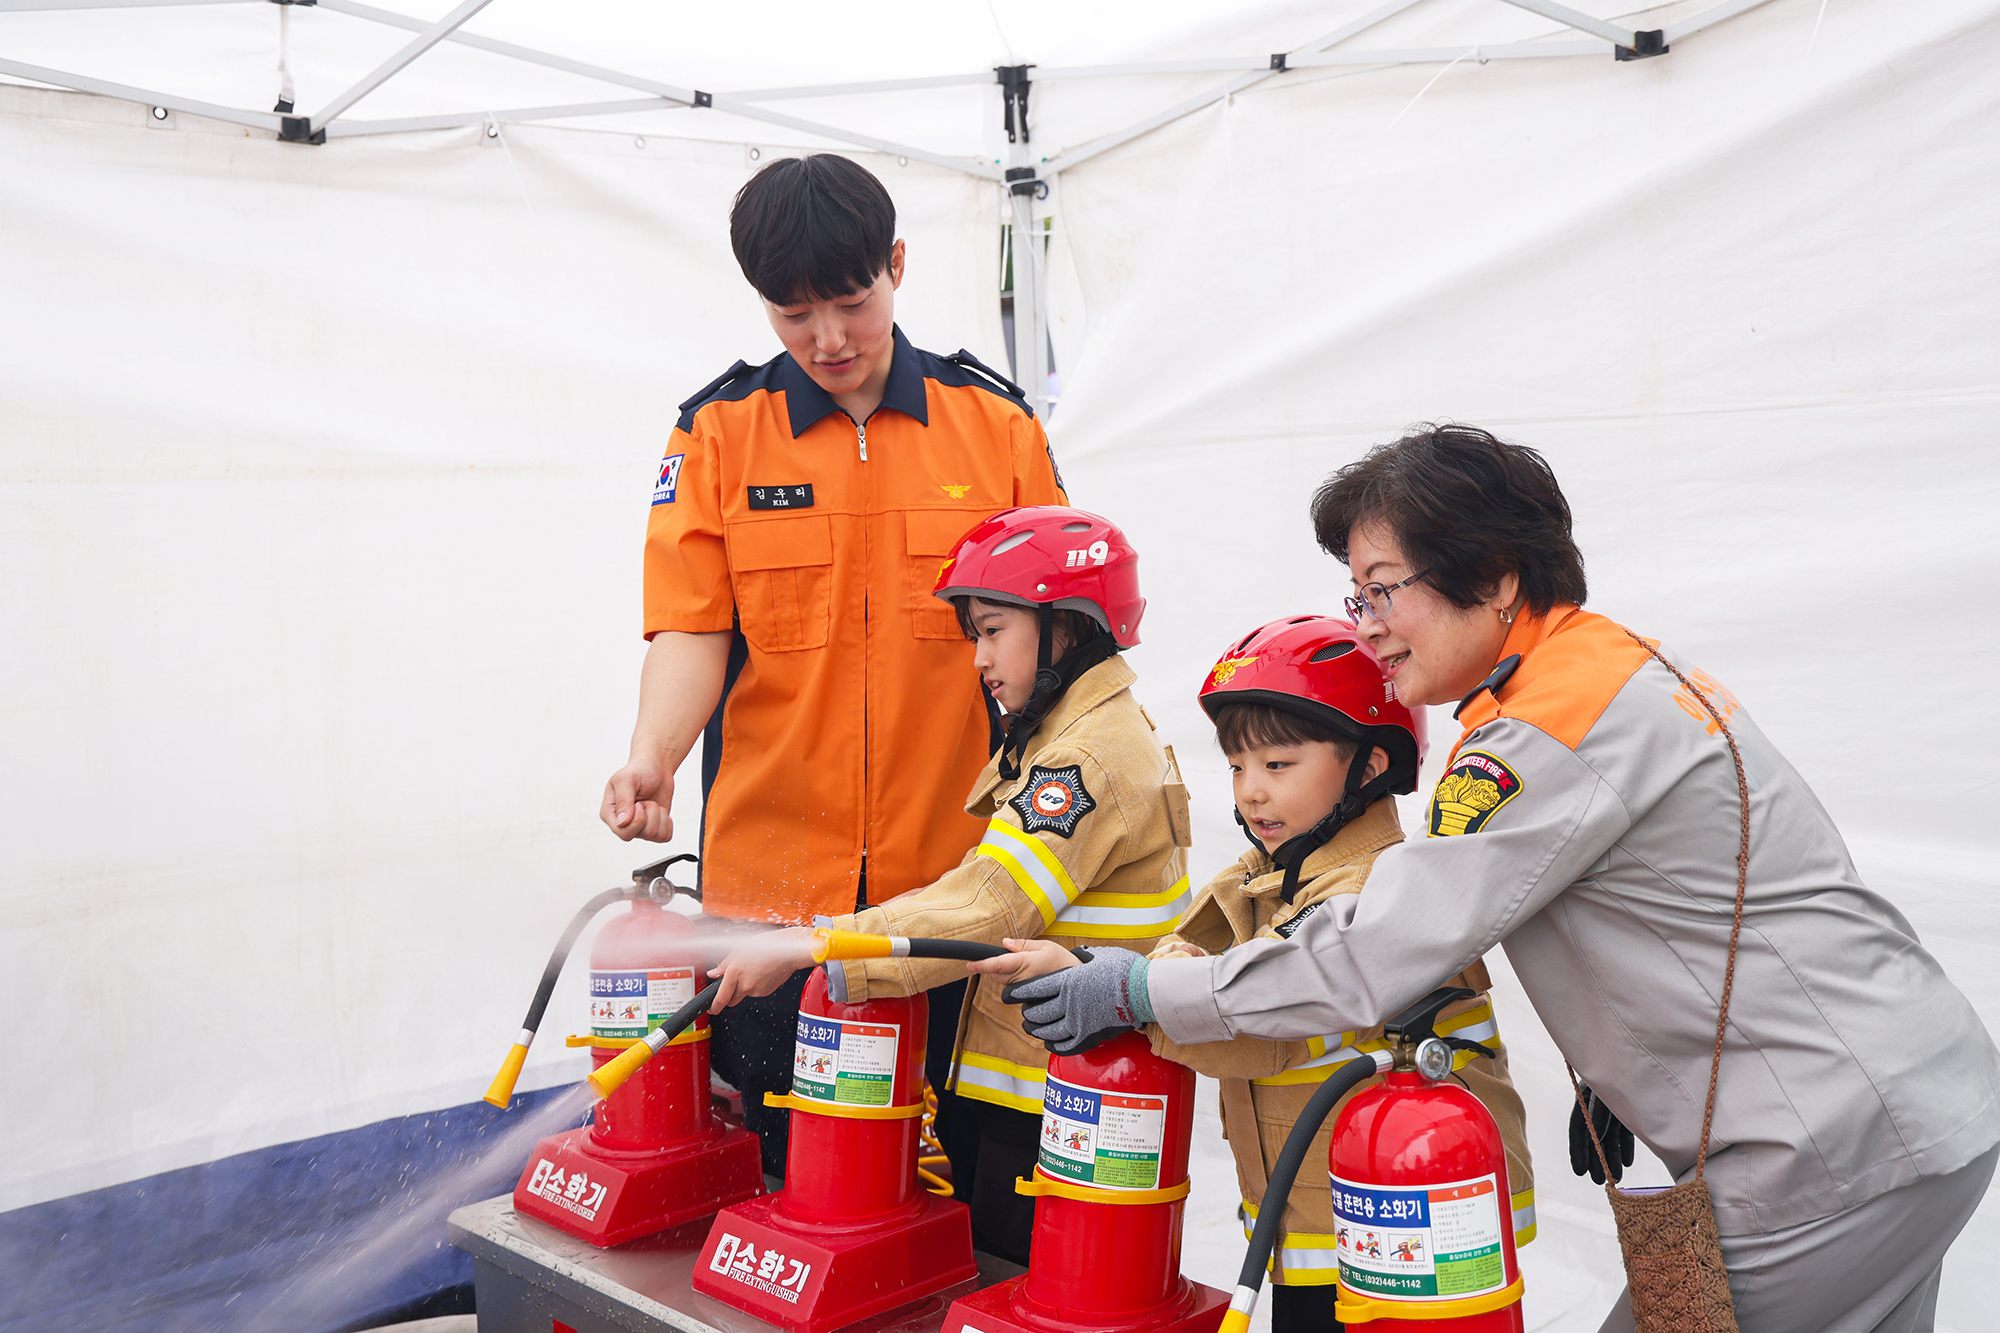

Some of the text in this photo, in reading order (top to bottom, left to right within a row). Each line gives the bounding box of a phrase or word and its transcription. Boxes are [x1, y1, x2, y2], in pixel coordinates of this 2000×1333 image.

[653, 491, 670, 501] OREA
[1066, 541, 1109, 567] 119
[1452, 755, 1504, 779] VOLUNTEER FIRE
[1040, 793, 1065, 804] 119
[615, 978, 643, 992] 소화기
[810, 1025, 836, 1044] 소화기
[1063, 1095, 1095, 1117] 소화기
[545, 1167, 607, 1212] 소화기
[541, 1188, 596, 1222] FIRE EXTINGUISHER
[1343, 1193, 1375, 1218] 훈련용
[1379, 1199, 1422, 1219] 소화기
[732, 1242, 811, 1293] 소화기
[727, 1267, 800, 1305] FIRE EXTINGUISHER
